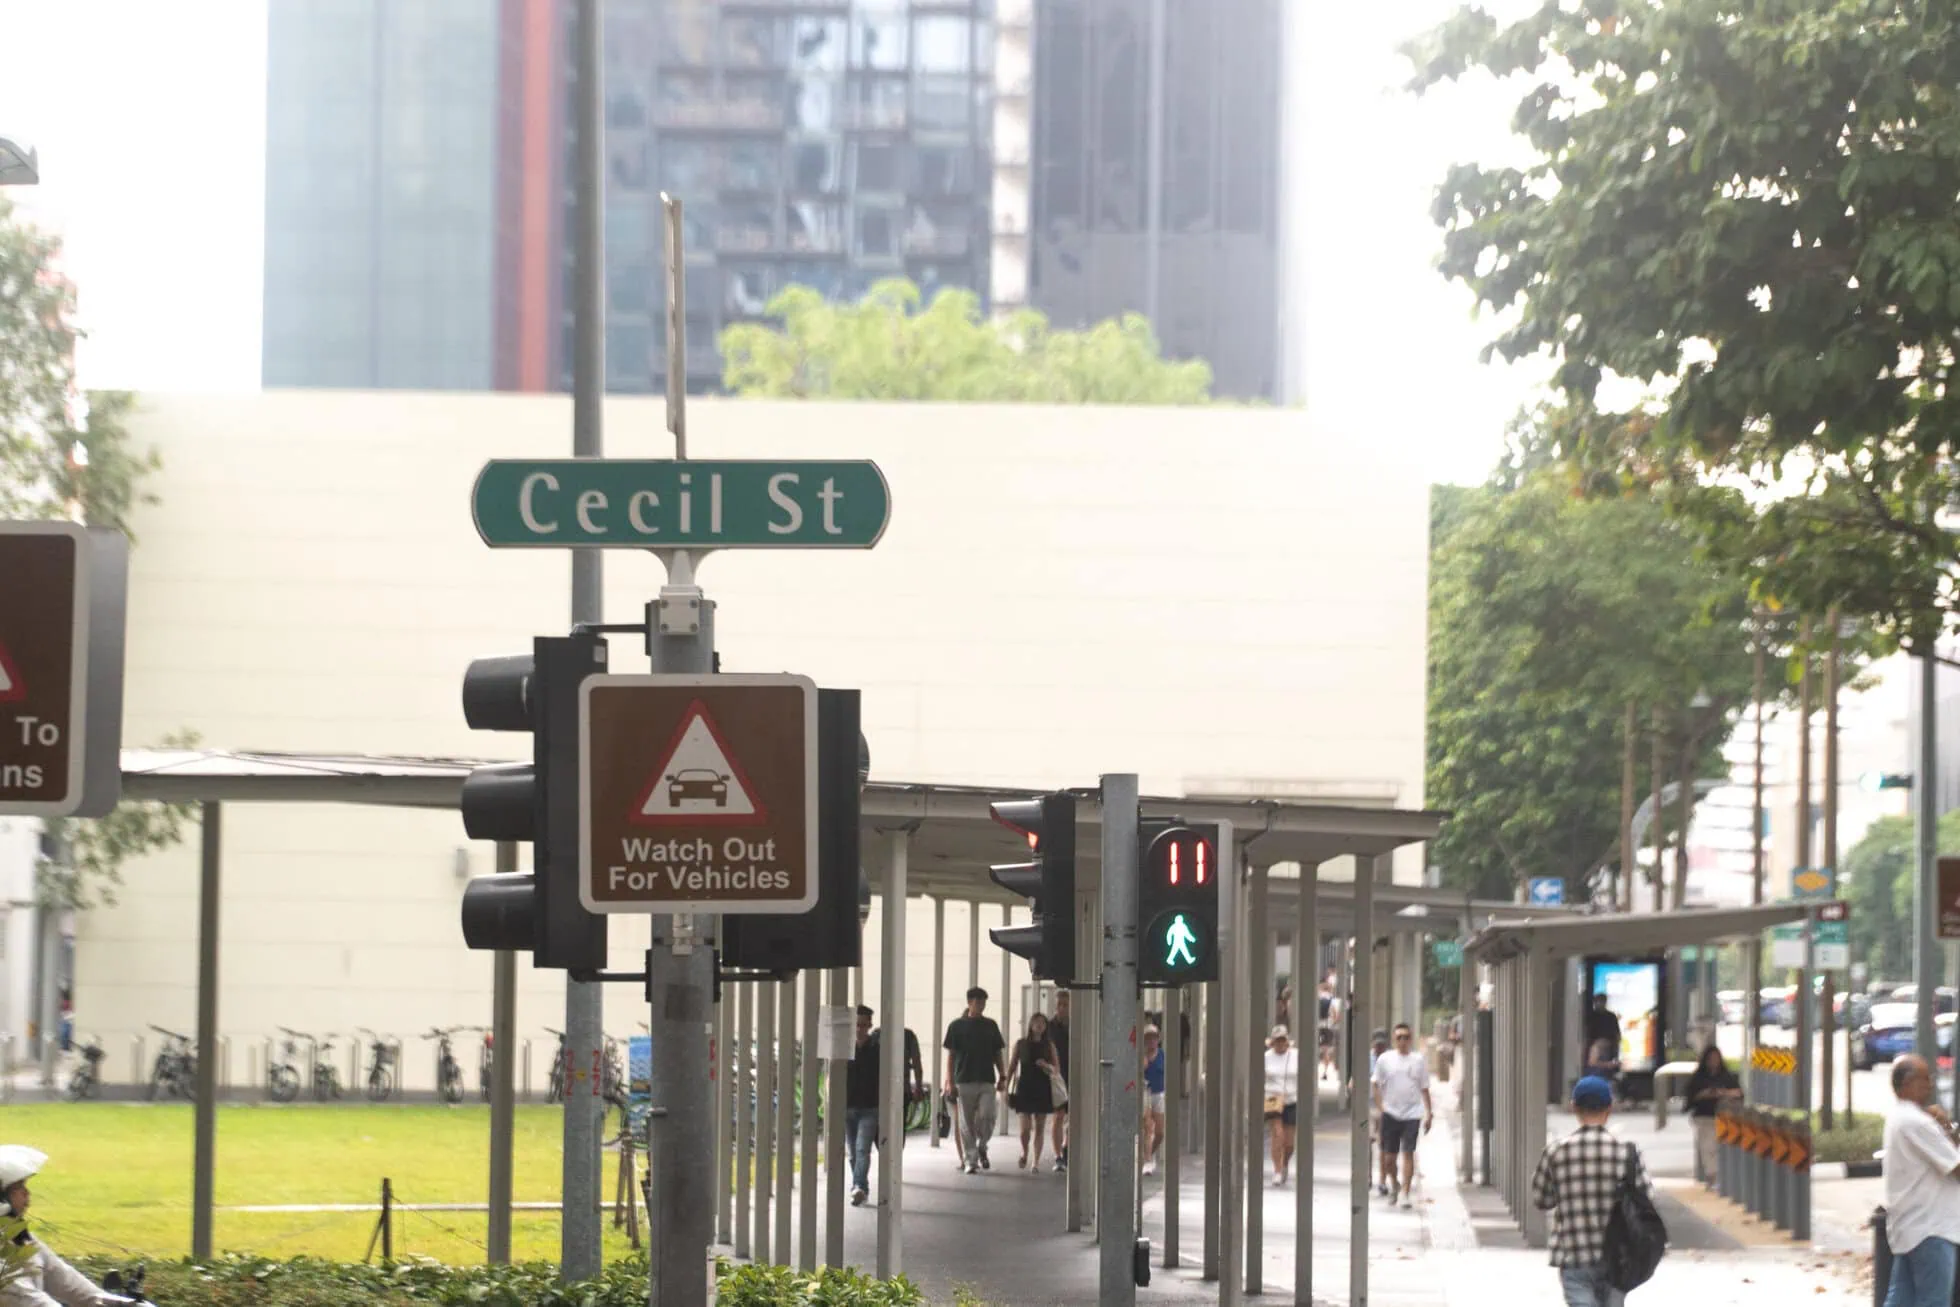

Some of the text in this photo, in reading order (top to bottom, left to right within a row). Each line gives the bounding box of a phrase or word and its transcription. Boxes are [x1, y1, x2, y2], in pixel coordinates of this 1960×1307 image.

[519, 472, 845, 534] Cecil St
[15, 715, 60, 746] To
[0, 764, 44, 788] ns
[621, 836, 776, 862] Watch Out
[1169, 840, 1205, 885] 11
[608, 865, 791, 891] For Vehicles
